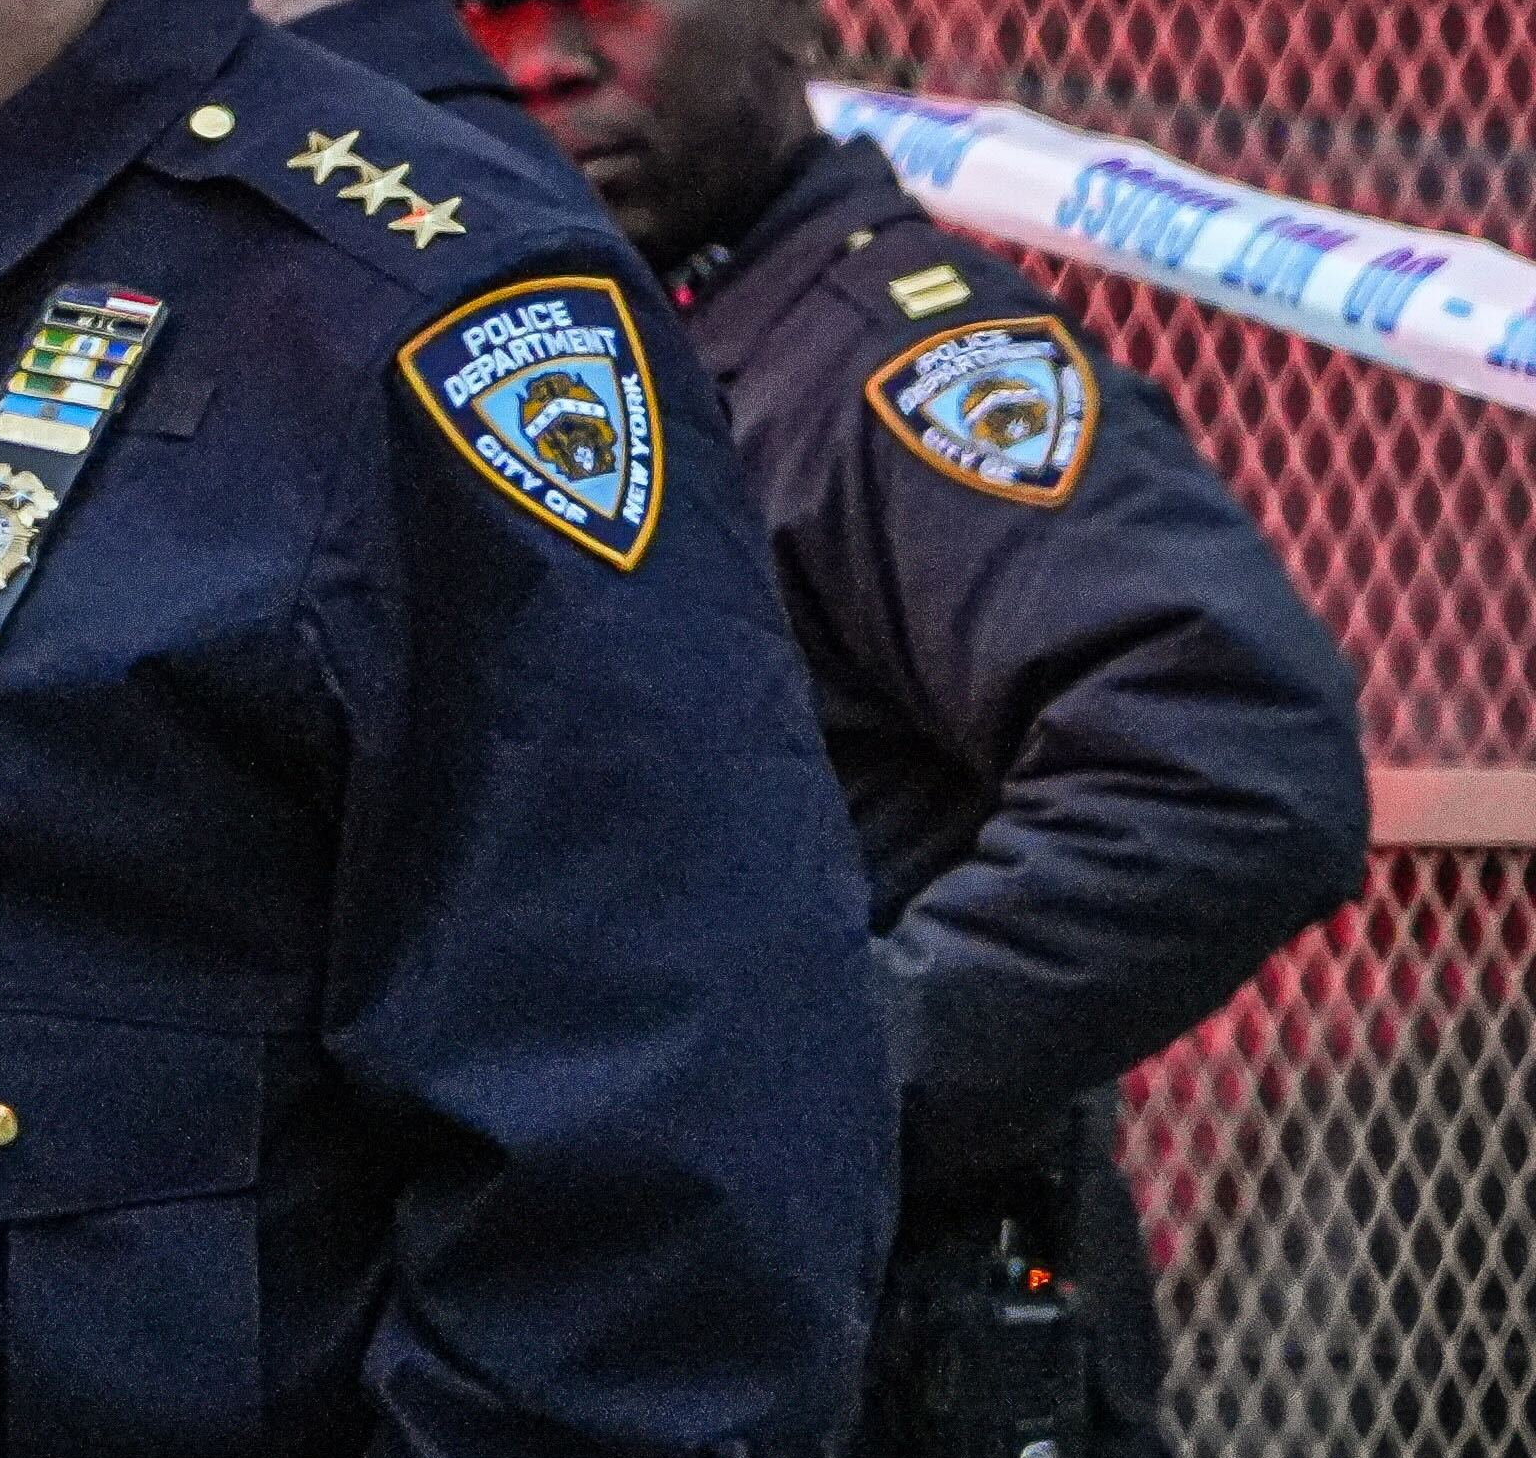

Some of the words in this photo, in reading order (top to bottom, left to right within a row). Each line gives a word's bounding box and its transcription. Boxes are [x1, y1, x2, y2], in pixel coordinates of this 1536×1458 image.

[443, 327, 618, 408] DEPARTMENT
[462, 300, 573, 357] POLICE
[475, 434, 543, 491] CITY
[544, 489, 589, 525] OF
